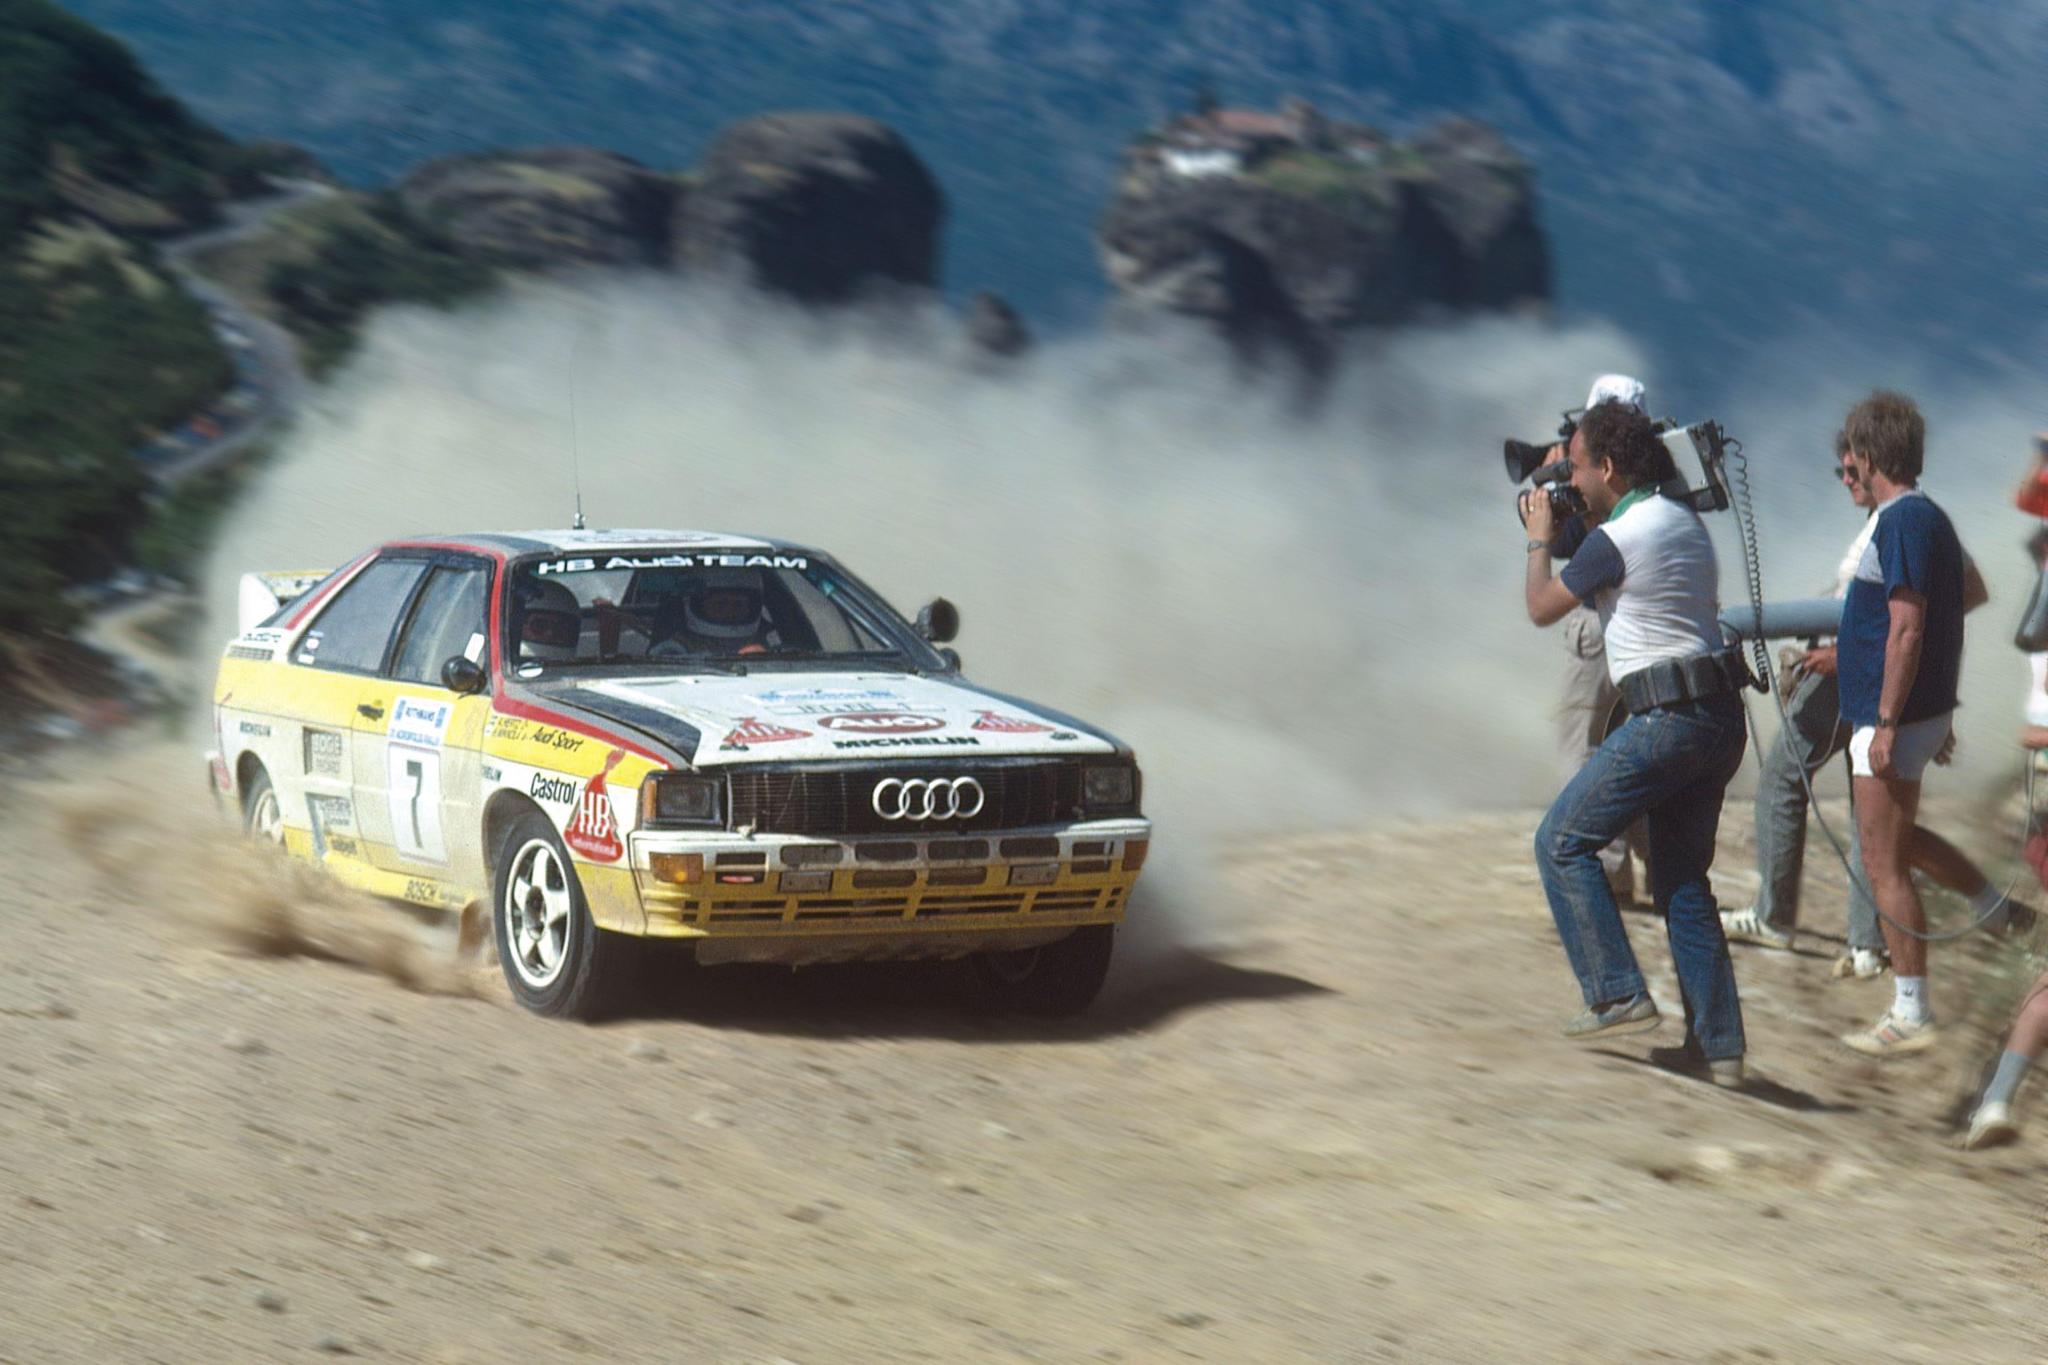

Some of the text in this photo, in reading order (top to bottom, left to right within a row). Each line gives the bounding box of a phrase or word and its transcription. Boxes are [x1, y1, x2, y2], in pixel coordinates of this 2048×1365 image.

[537, 558, 596, 575] HB
[696, 553, 807, 570] TEAM
[553, 731, 584, 752] Sport
[833, 736, 981, 749] MICHELIN
[530, 772, 577, 805] Castrol
[406, 760, 423, 849] 7
[579, 790, 611, 838] HB
